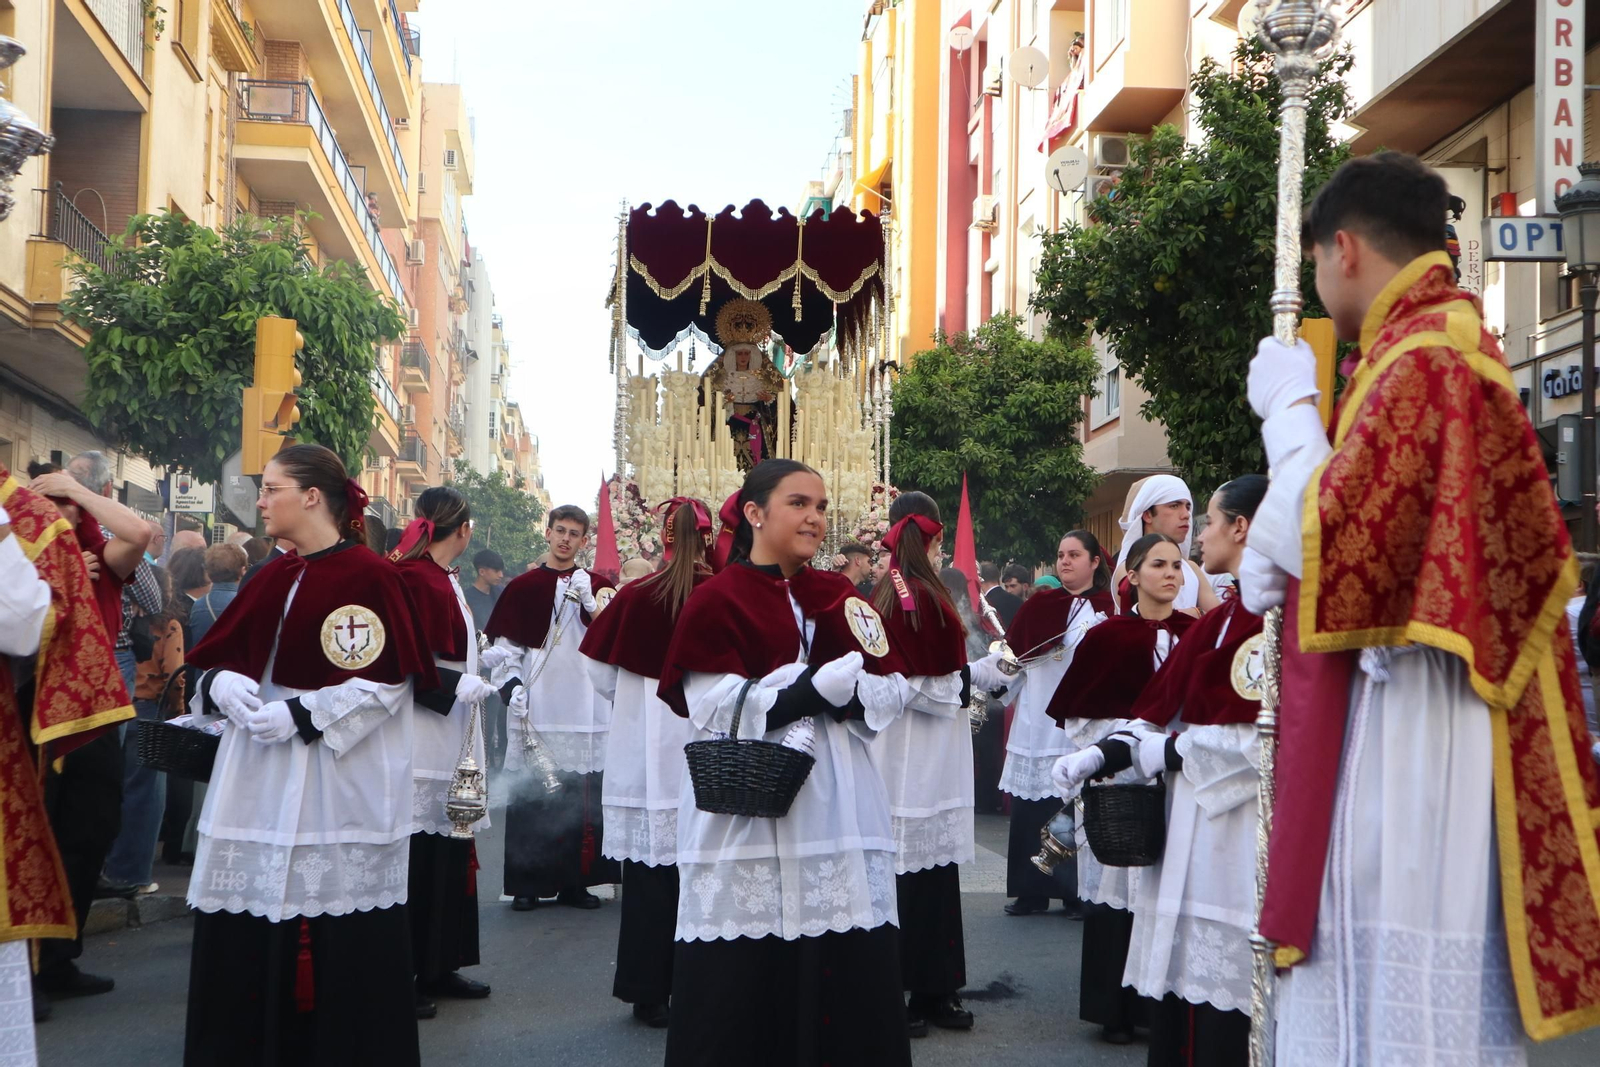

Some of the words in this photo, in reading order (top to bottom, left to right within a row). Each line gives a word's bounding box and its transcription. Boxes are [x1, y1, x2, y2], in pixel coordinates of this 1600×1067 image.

[1554, 0, 1573, 198] RBANO
[1500, 222, 1563, 251] OPT
[1543, 365, 1583, 399] Gafa
